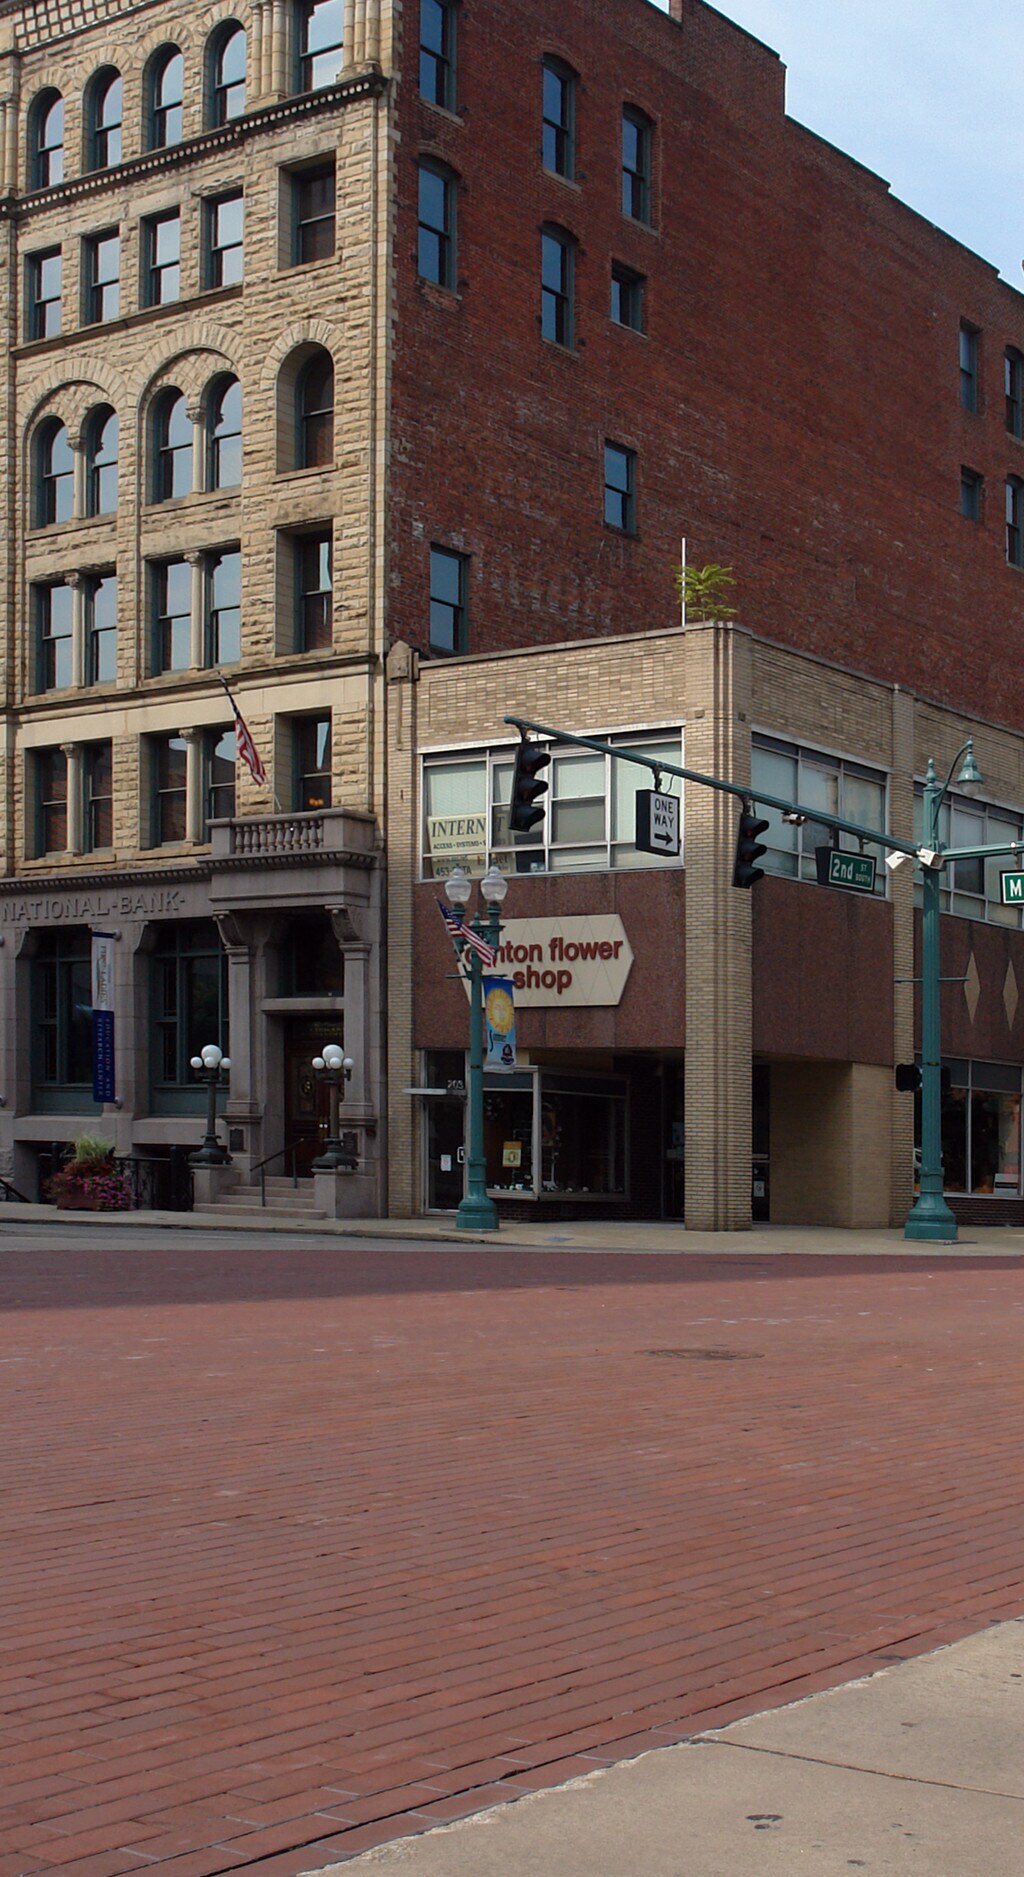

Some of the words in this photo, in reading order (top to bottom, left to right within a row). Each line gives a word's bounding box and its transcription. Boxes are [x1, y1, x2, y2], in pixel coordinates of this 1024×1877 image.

[655, 798, 674, 814] ONE
[432, 815, 505, 838] INTERNT
[654, 813, 674, 829] WAY
[832, 858, 854, 880] 2nd
[855, 872, 871, 884] SOUTH
[860, 863, 868, 872] ST
[2, 896, 110, 922] NATIONAL
[119, 890, 180, 915] BANK
[548, 937, 624, 962] flower
[512, 965, 573, 995] shop
